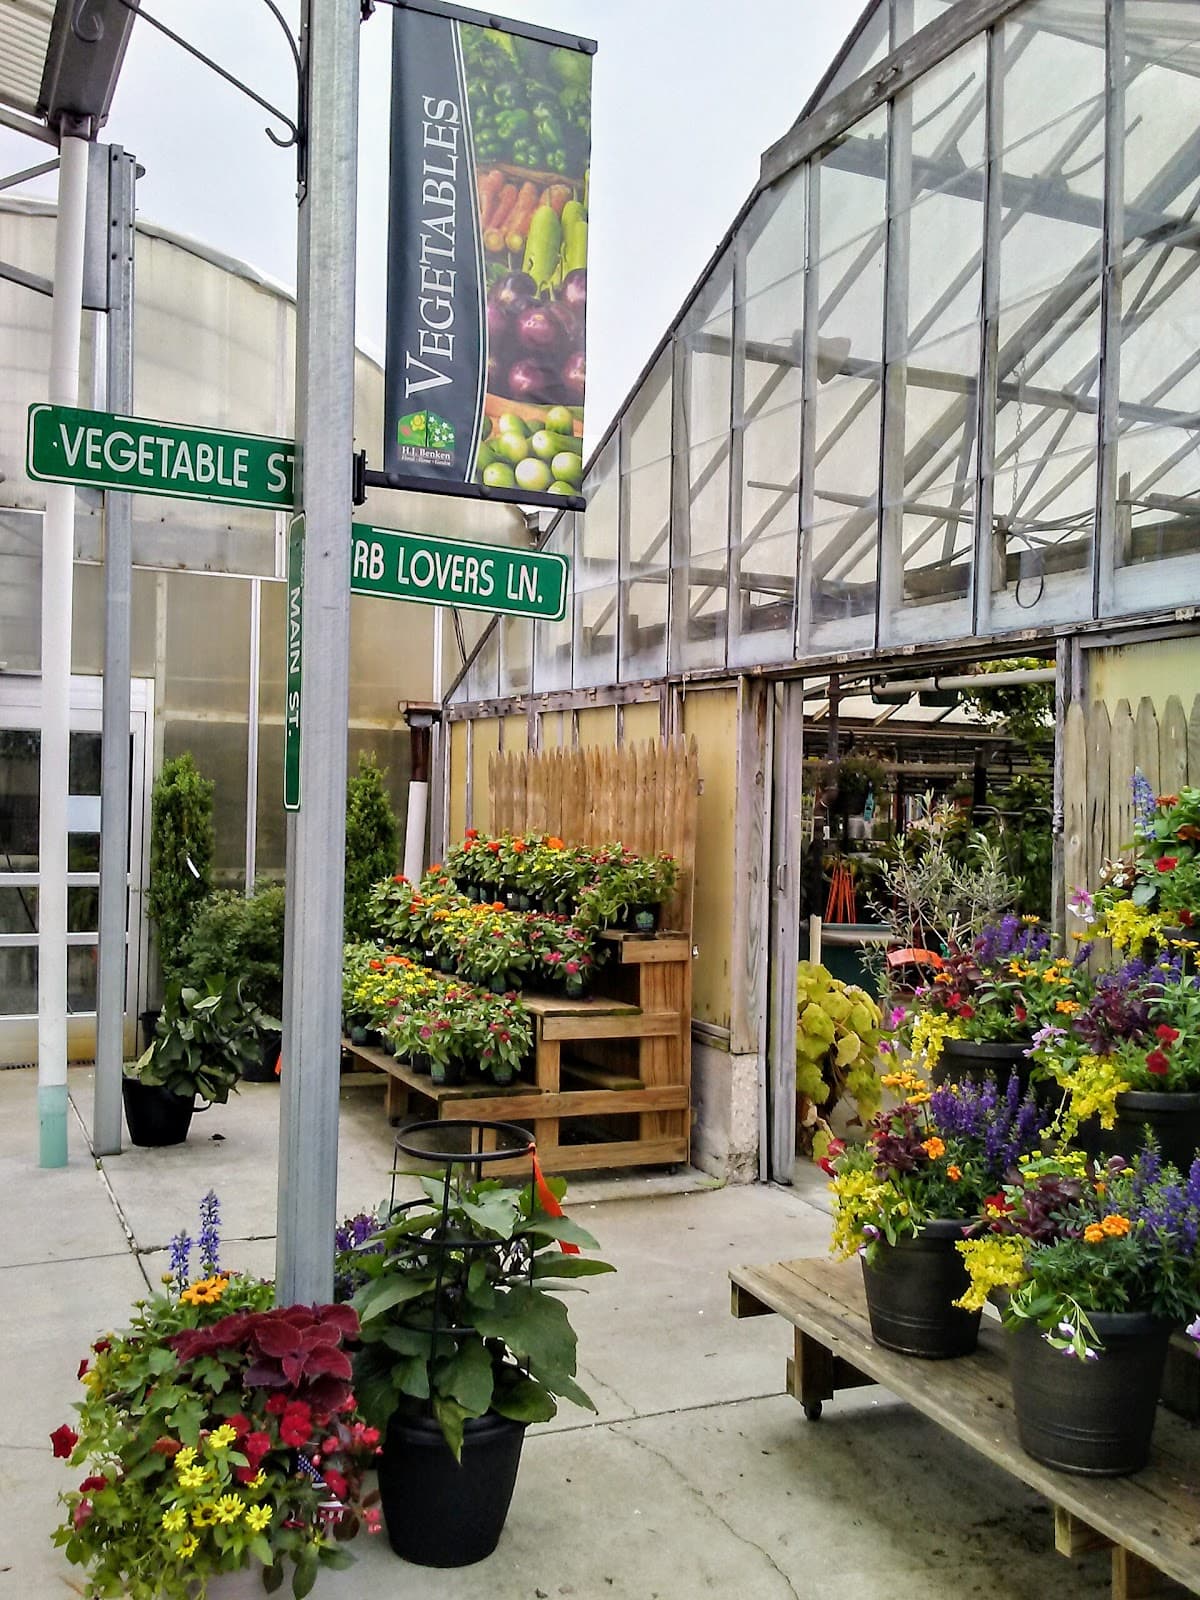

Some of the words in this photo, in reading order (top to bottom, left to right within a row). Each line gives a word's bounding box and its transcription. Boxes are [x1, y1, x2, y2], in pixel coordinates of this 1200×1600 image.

[404, 95, 461, 399] VEGETABLES
[59, 423, 249, 489] VEGETABLE
[419, 448, 451, 460] Benken
[352, 539, 384, 580] RB
[397, 546, 495, 597] LOVERS
[506, 563, 543, 603] LN.
[288, 586, 301, 674] MAIN
[288, 690, 300, 737] ST.
